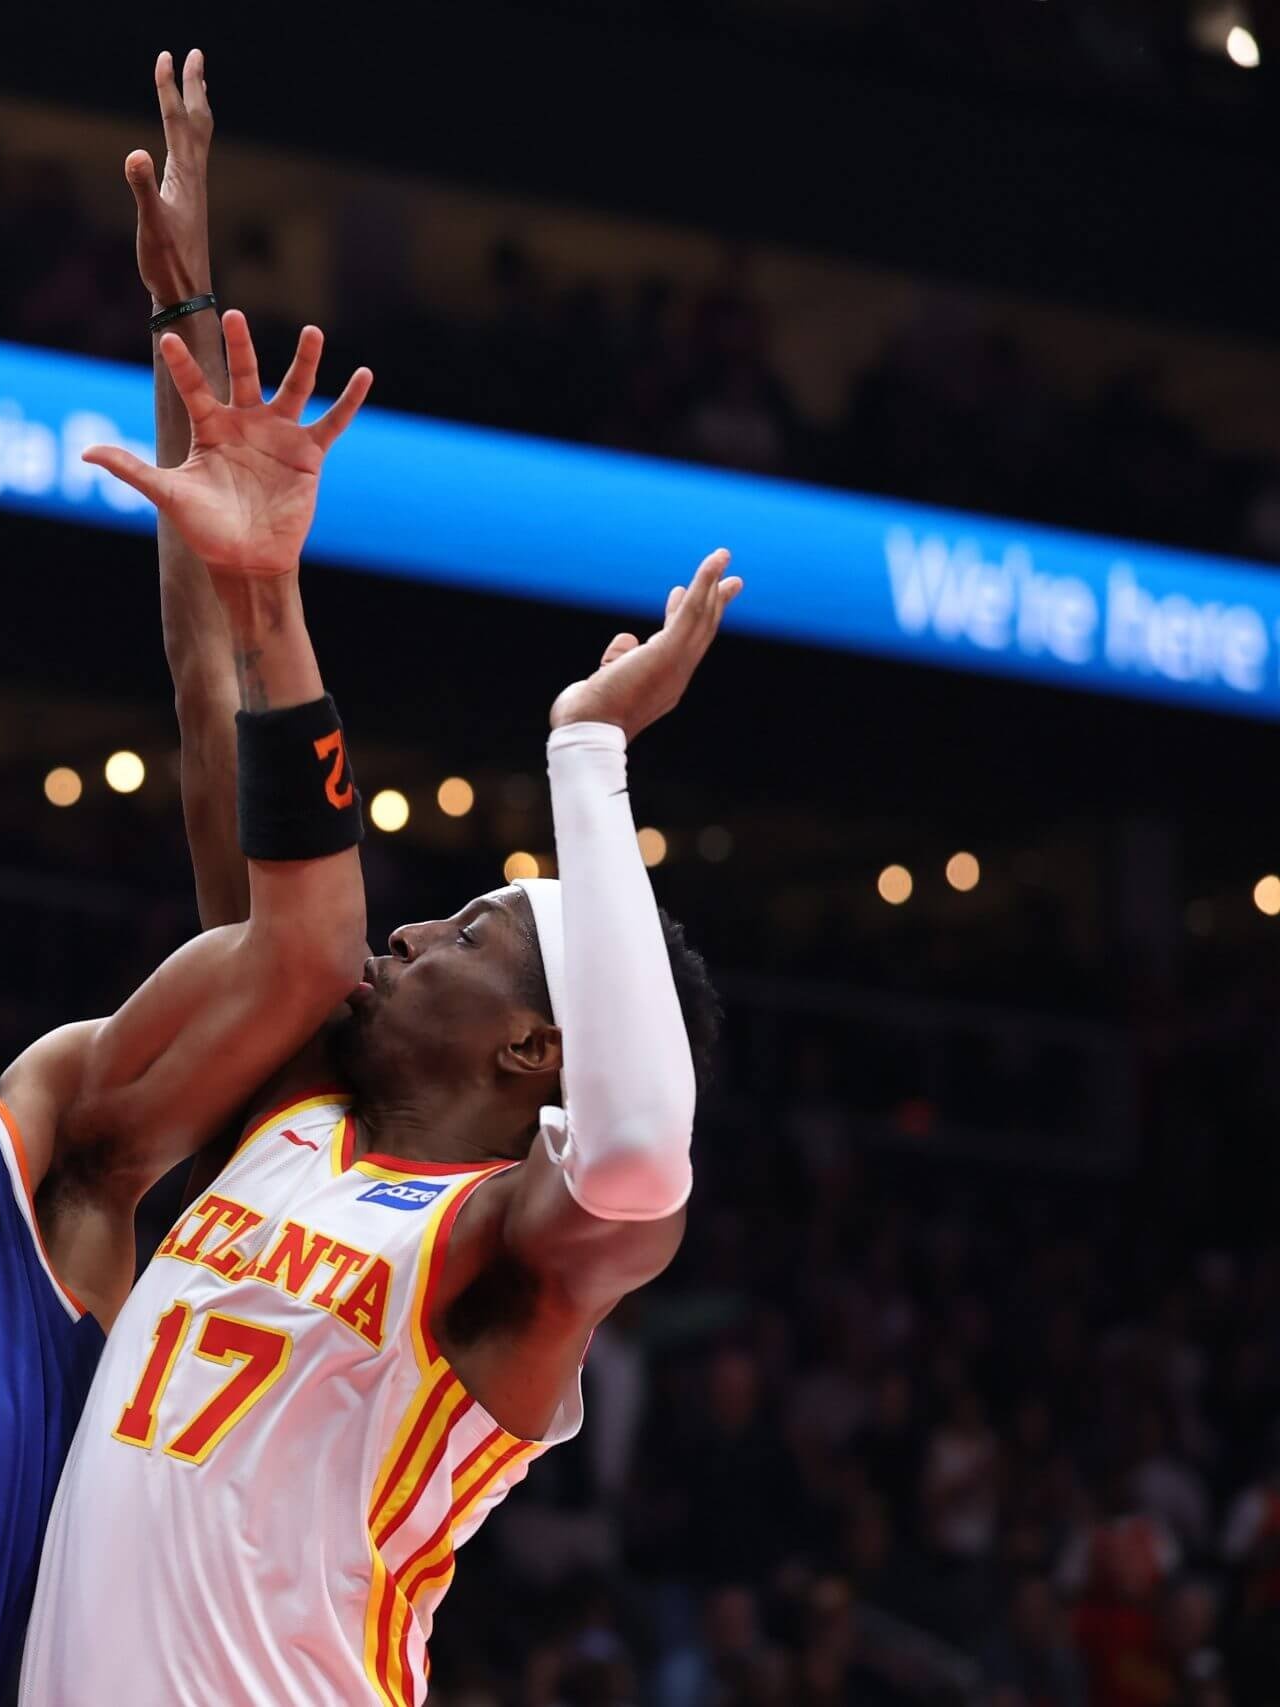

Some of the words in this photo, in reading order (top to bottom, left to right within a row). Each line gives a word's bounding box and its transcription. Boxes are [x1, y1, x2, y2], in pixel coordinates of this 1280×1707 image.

[885, 524, 1099, 664] We're
[1106, 560, 1268, 692] here
[111, 1299, 294, 1465] 17
